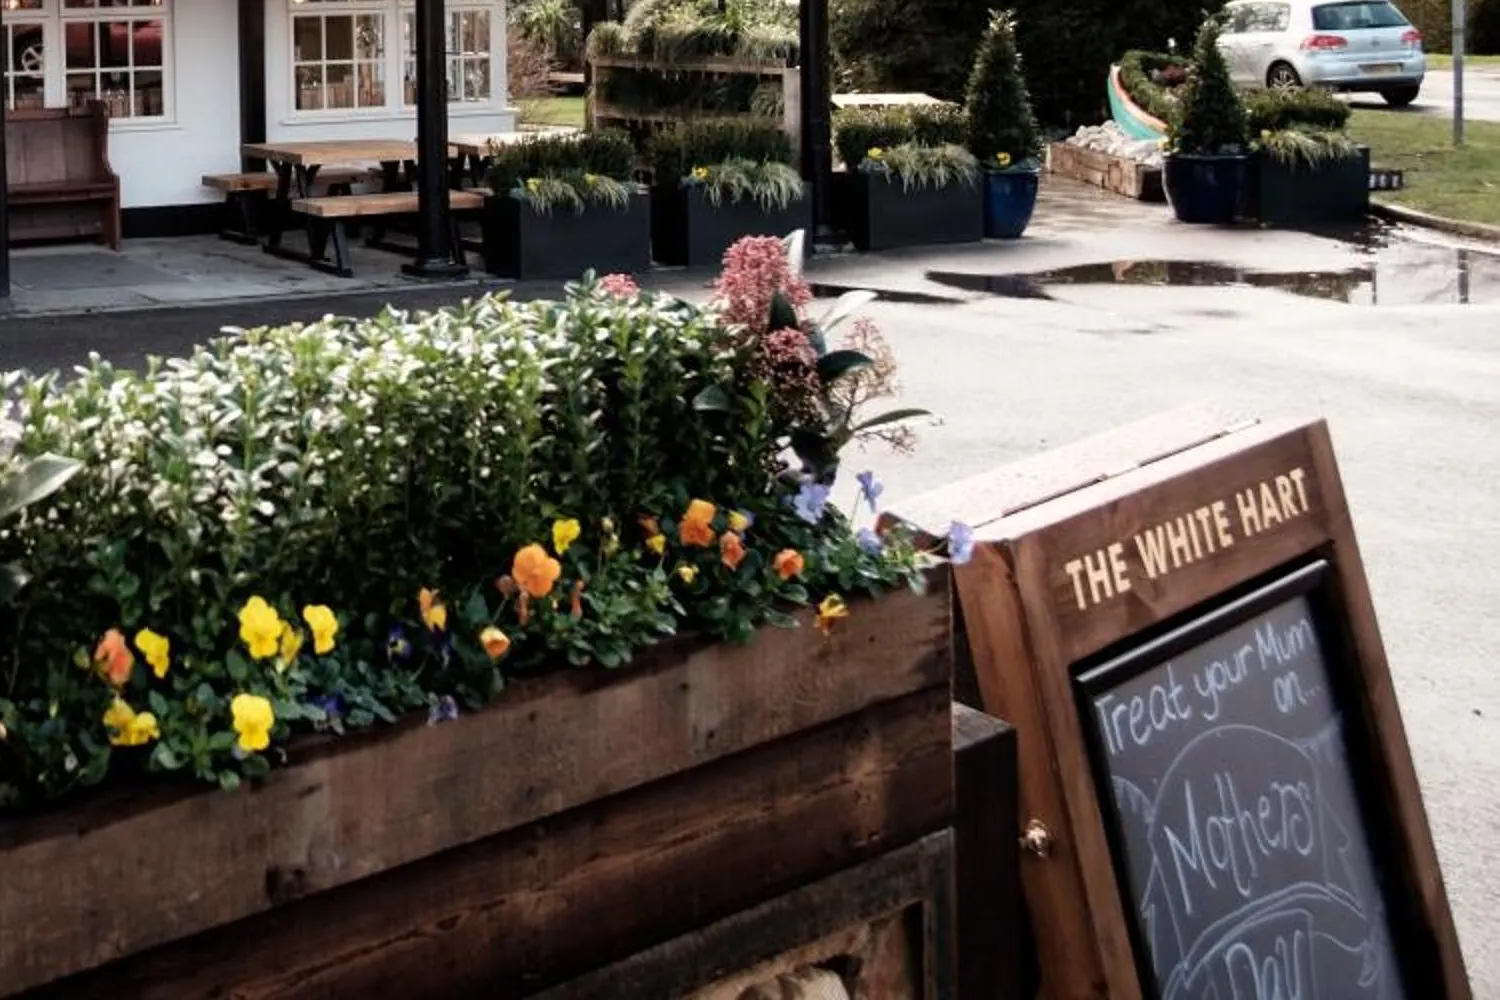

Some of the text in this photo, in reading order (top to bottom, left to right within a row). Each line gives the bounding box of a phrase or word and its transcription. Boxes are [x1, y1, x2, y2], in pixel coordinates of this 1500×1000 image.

[1064, 467, 1311, 611] THE WHITE HART
[1094, 616, 1316, 757] Treat your Mum
